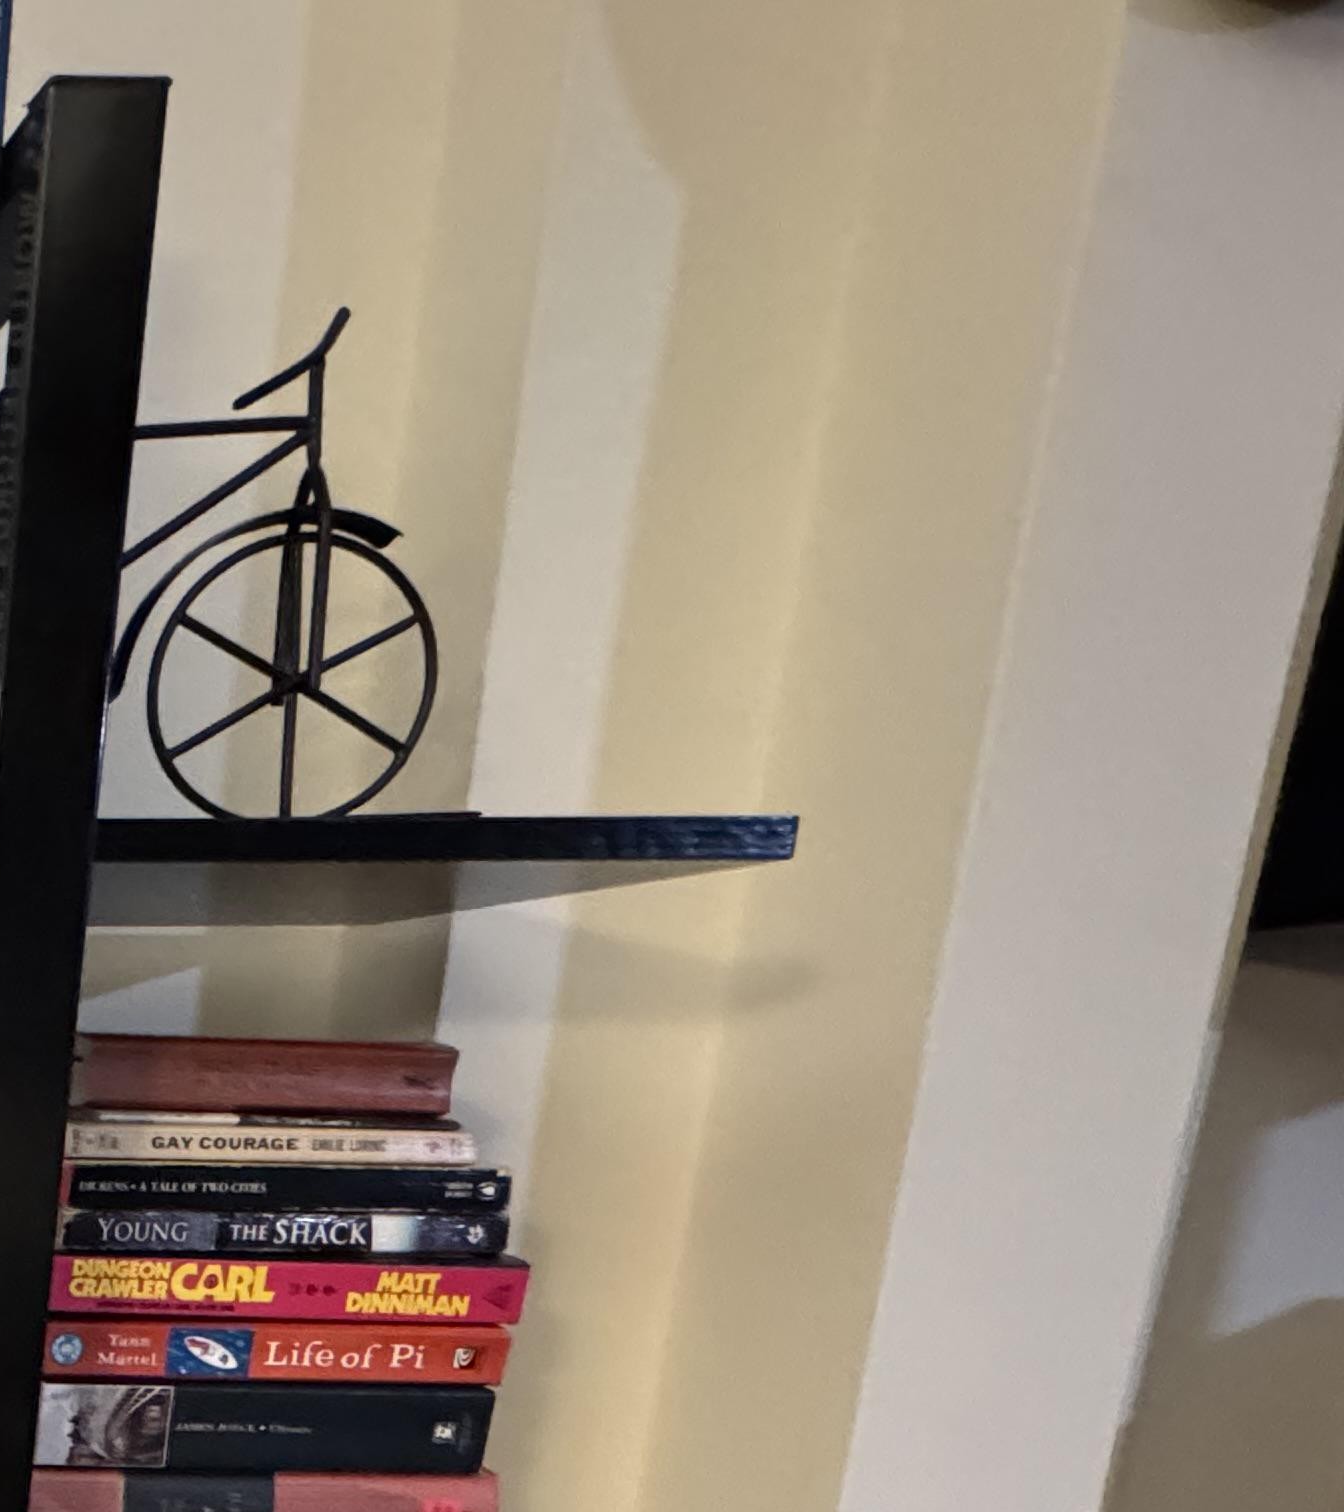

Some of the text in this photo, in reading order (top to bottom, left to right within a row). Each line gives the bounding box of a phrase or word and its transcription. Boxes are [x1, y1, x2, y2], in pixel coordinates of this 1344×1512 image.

[152, 1135, 298, 1152] GAY COURAGE
[98, 1218, 367, 1246] YOUNG THE SHACK
[72, 1259, 171, 1279] DUNGEON
[69, 1264, 276, 1302] CRAWLER CARL
[376, 1271, 442, 1293] MATT
[345, 1292, 470, 1316] DINNIMAN
[264, 1340, 425, 1369] Life of Pi
